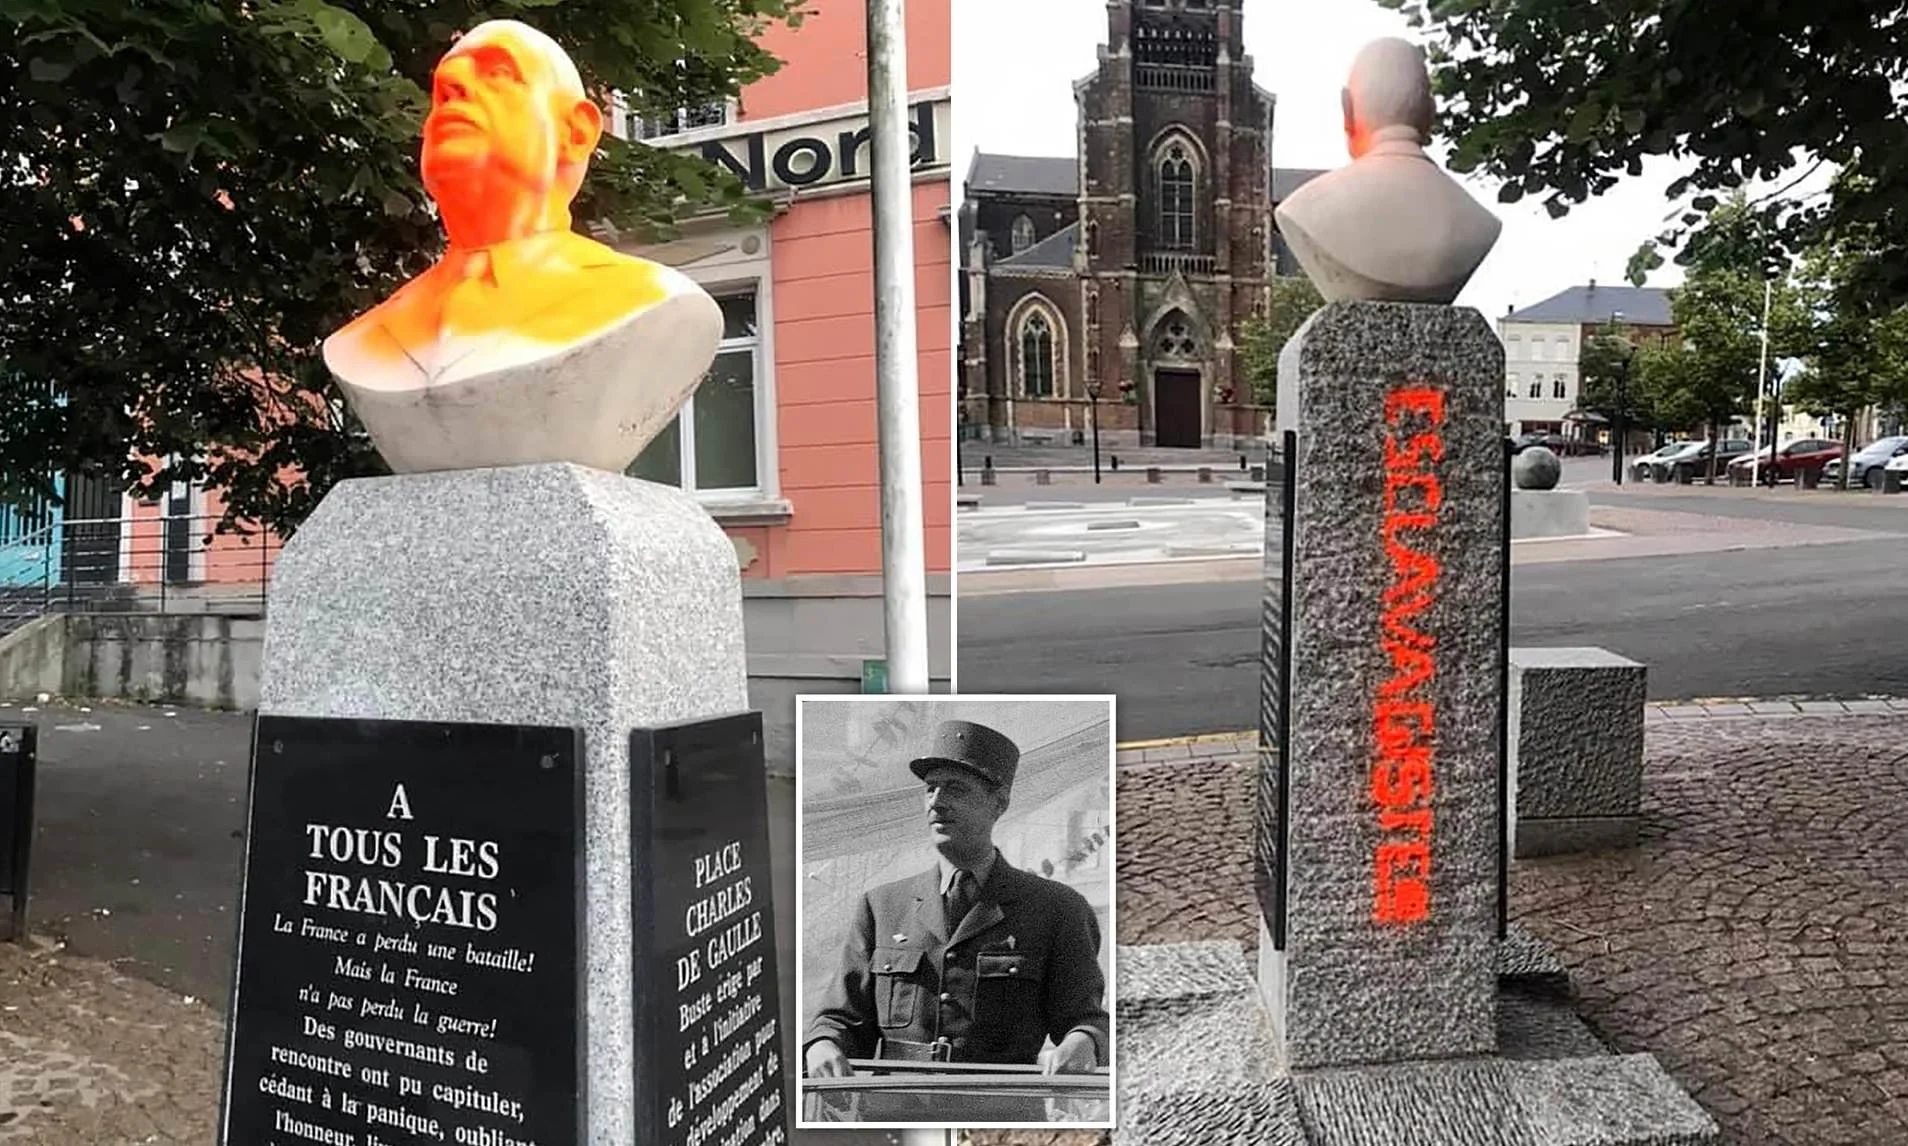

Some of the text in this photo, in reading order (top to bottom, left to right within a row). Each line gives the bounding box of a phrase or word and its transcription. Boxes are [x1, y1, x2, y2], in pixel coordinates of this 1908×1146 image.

[701, 101, 937, 190] Nord
[386, 783, 414, 820] A
[306, 824, 500, 880] TOUS LES
[694, 841, 742, 889] PLACE
[303, 870, 498, 932] FRANÇAIS
[686, 876, 753, 937] CHARLES
[273, 913, 536, 973] La France a perdu une bataille!
[676, 911, 762, 992] DE GAULLE
[334, 956, 458, 995] Mais la France
[679, 992, 713, 1032] Buste
[746, 956, 763, 987] par
[299, 983, 498, 1040] n'a pas perdu la guerre!
[684, 994, 762, 1070] et à l'initiative
[303, 1016, 488, 1074] Des gouvernants de
[668, 1019, 776, 1129] de l'association pour
[767, 1050, 779, 1076] de
[259, 1073, 313, 1104] cédant
[321, 1087, 332, 1109] à
[342, 1092, 358, 1116] la
[366, 1103, 445, 1142] panique,
[455, 1126, 537, 1146] oublia
[271, 1046, 524, 1123] rencontre ont pu capituler,
[759, 1088, 781, 1123] dans
